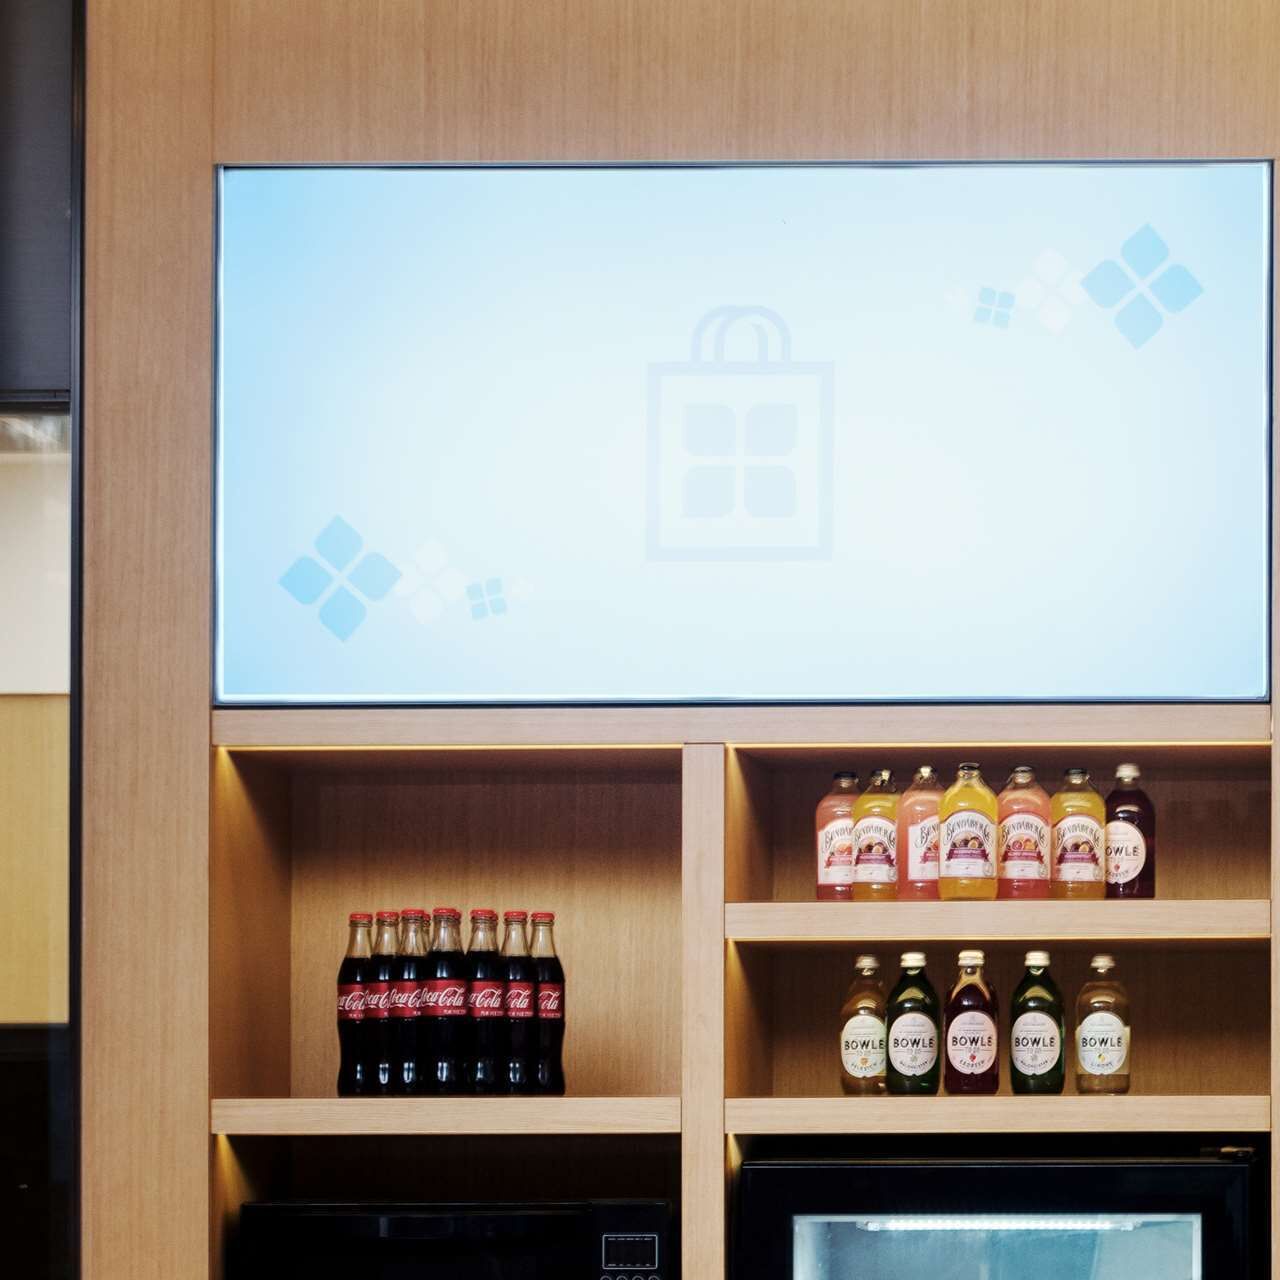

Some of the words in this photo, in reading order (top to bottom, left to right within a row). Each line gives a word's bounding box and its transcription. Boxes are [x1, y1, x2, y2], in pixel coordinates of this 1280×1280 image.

[1105, 846, 1140, 857] OWLE
[421, 986, 466, 1007] Coca-Cola
[844, 1039, 885, 1050] BOWLE
[893, 1038, 935, 1049] BOWLE
[951, 1036, 993, 1047] BOWLE
[1014, 1036, 1055, 1047] BOWLE
[1081, 1037, 1122, 1048] BOWLE
